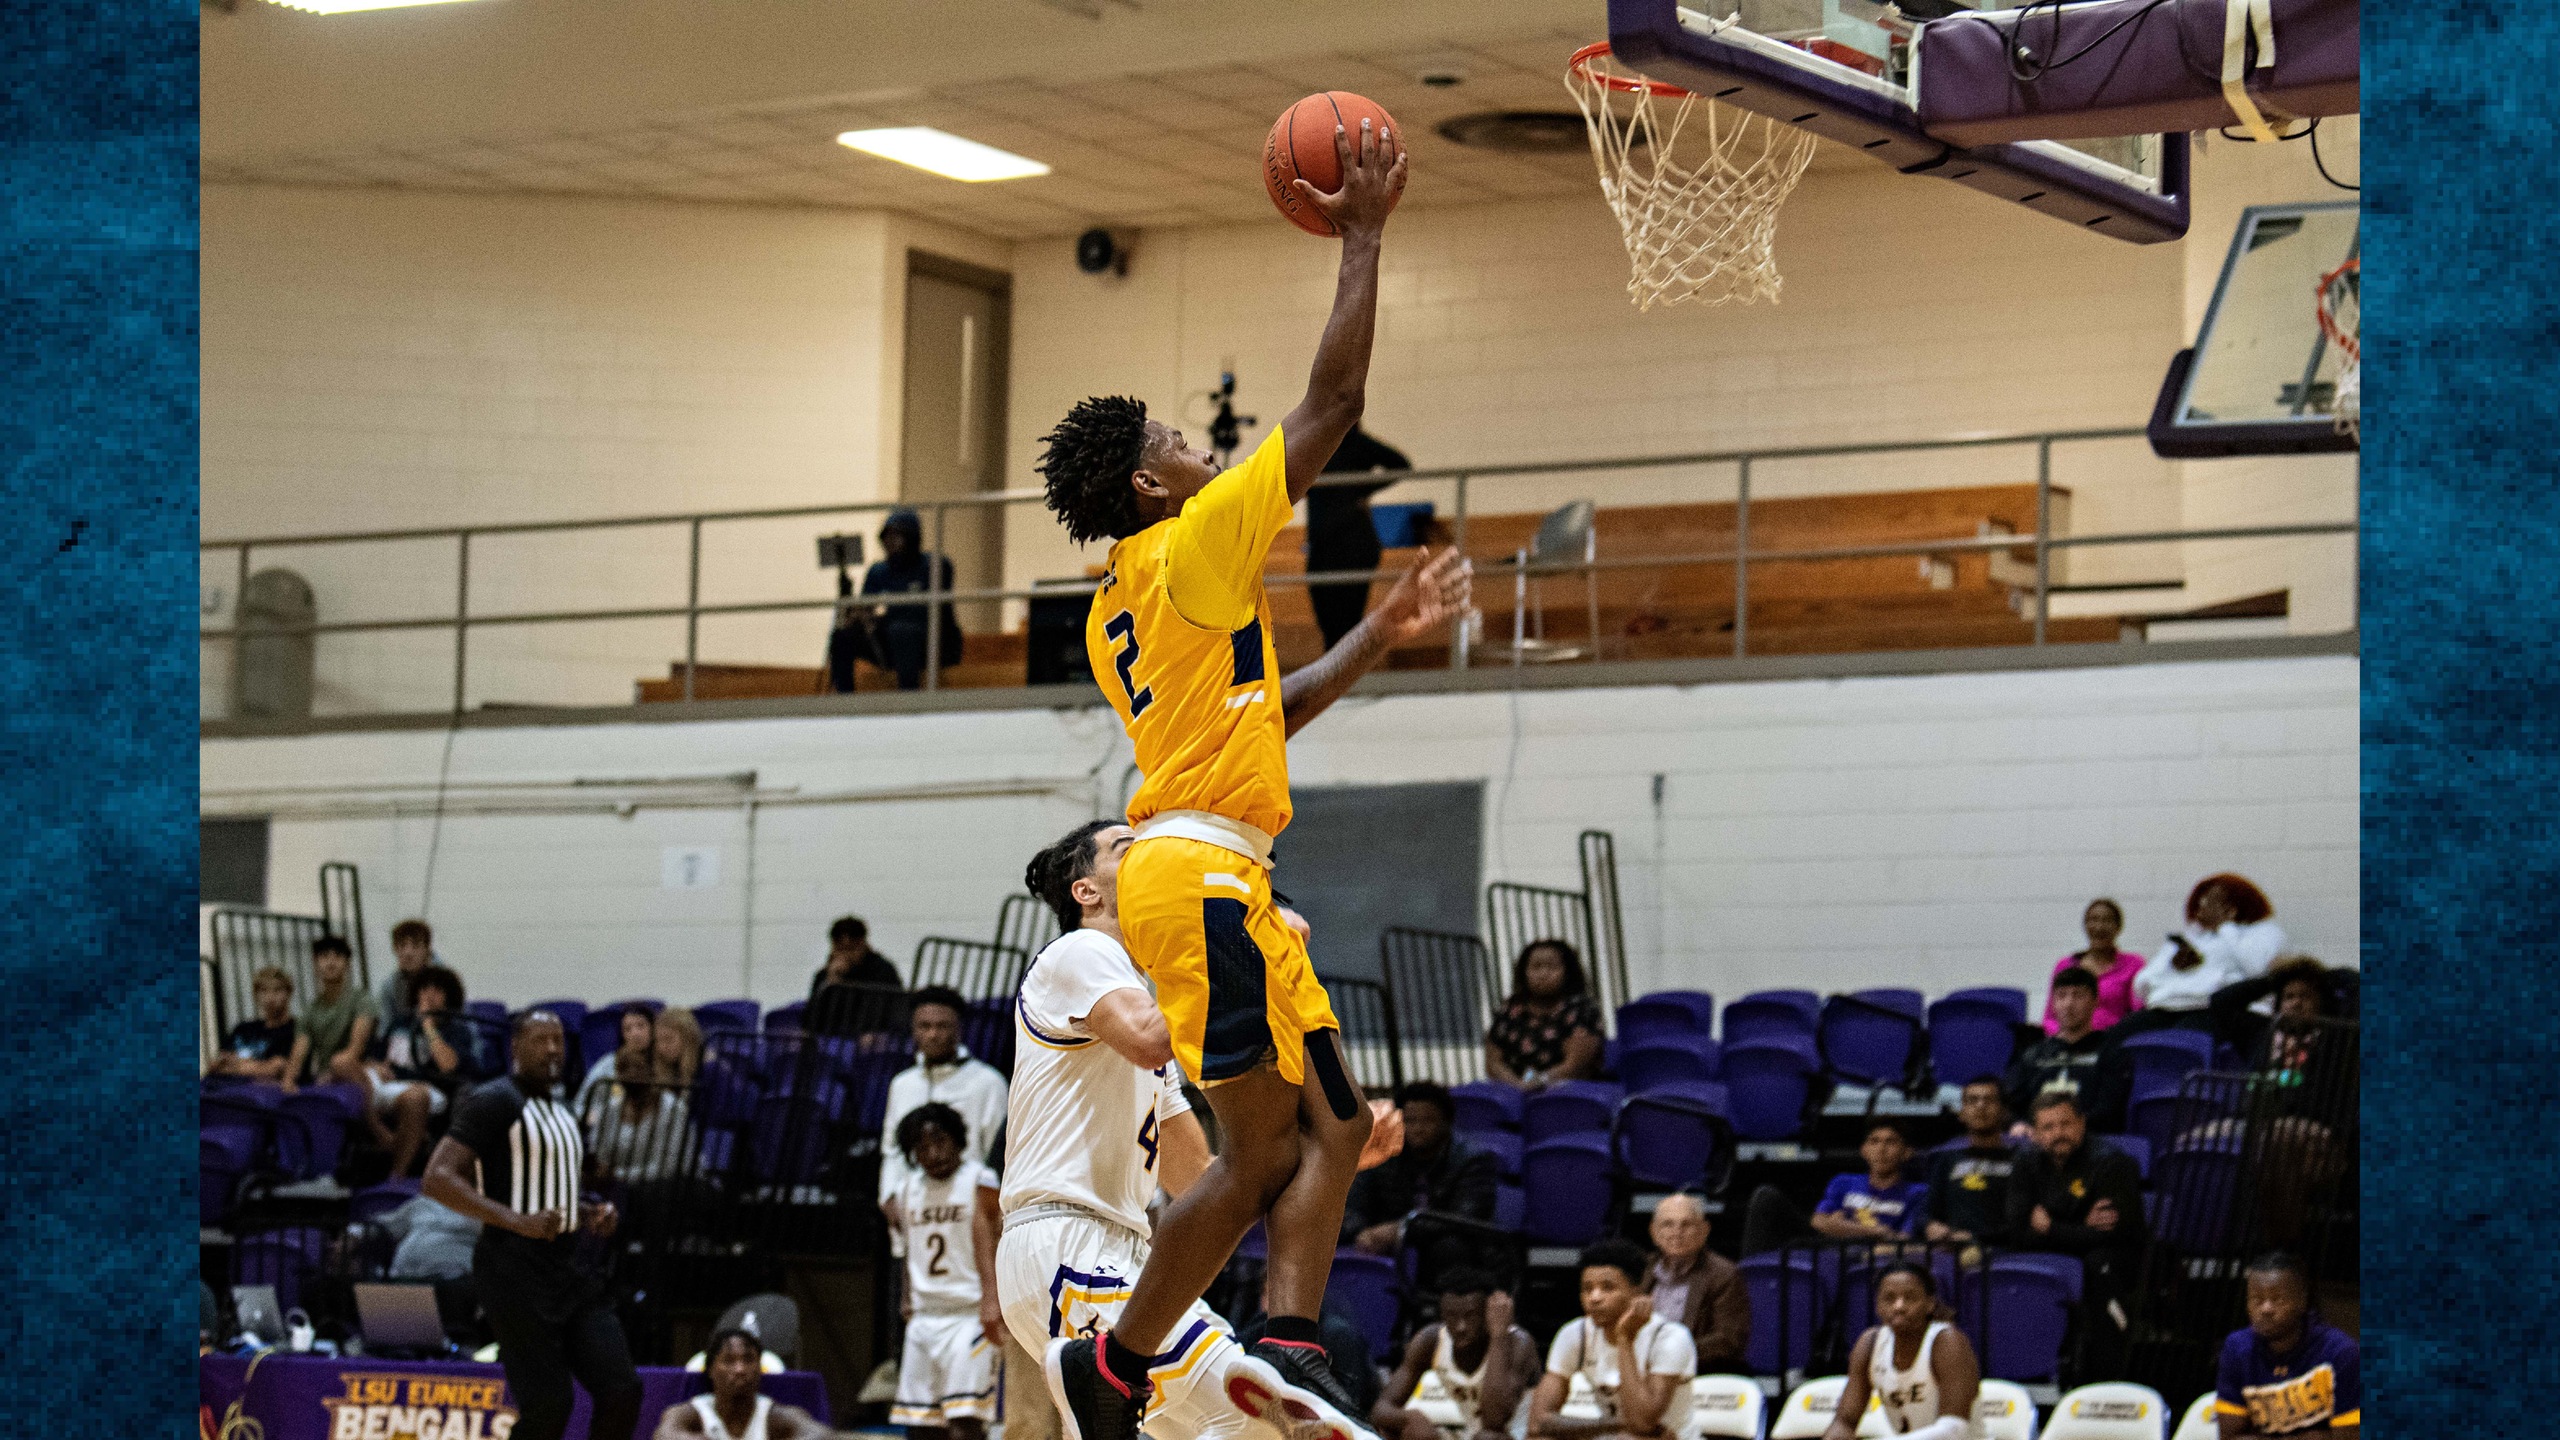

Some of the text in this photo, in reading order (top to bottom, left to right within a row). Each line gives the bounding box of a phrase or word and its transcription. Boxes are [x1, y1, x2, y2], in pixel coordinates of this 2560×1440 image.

[1103, 607, 1154, 723] 2
[1137, 1091, 1159, 1174] 4
[909, 1204, 967, 1227] LSUE
[926, 1232, 949, 1277] 2
[350, 1379, 499, 1410] LSU EUNICE
[336, 1404, 517, 1440] BENGALS
